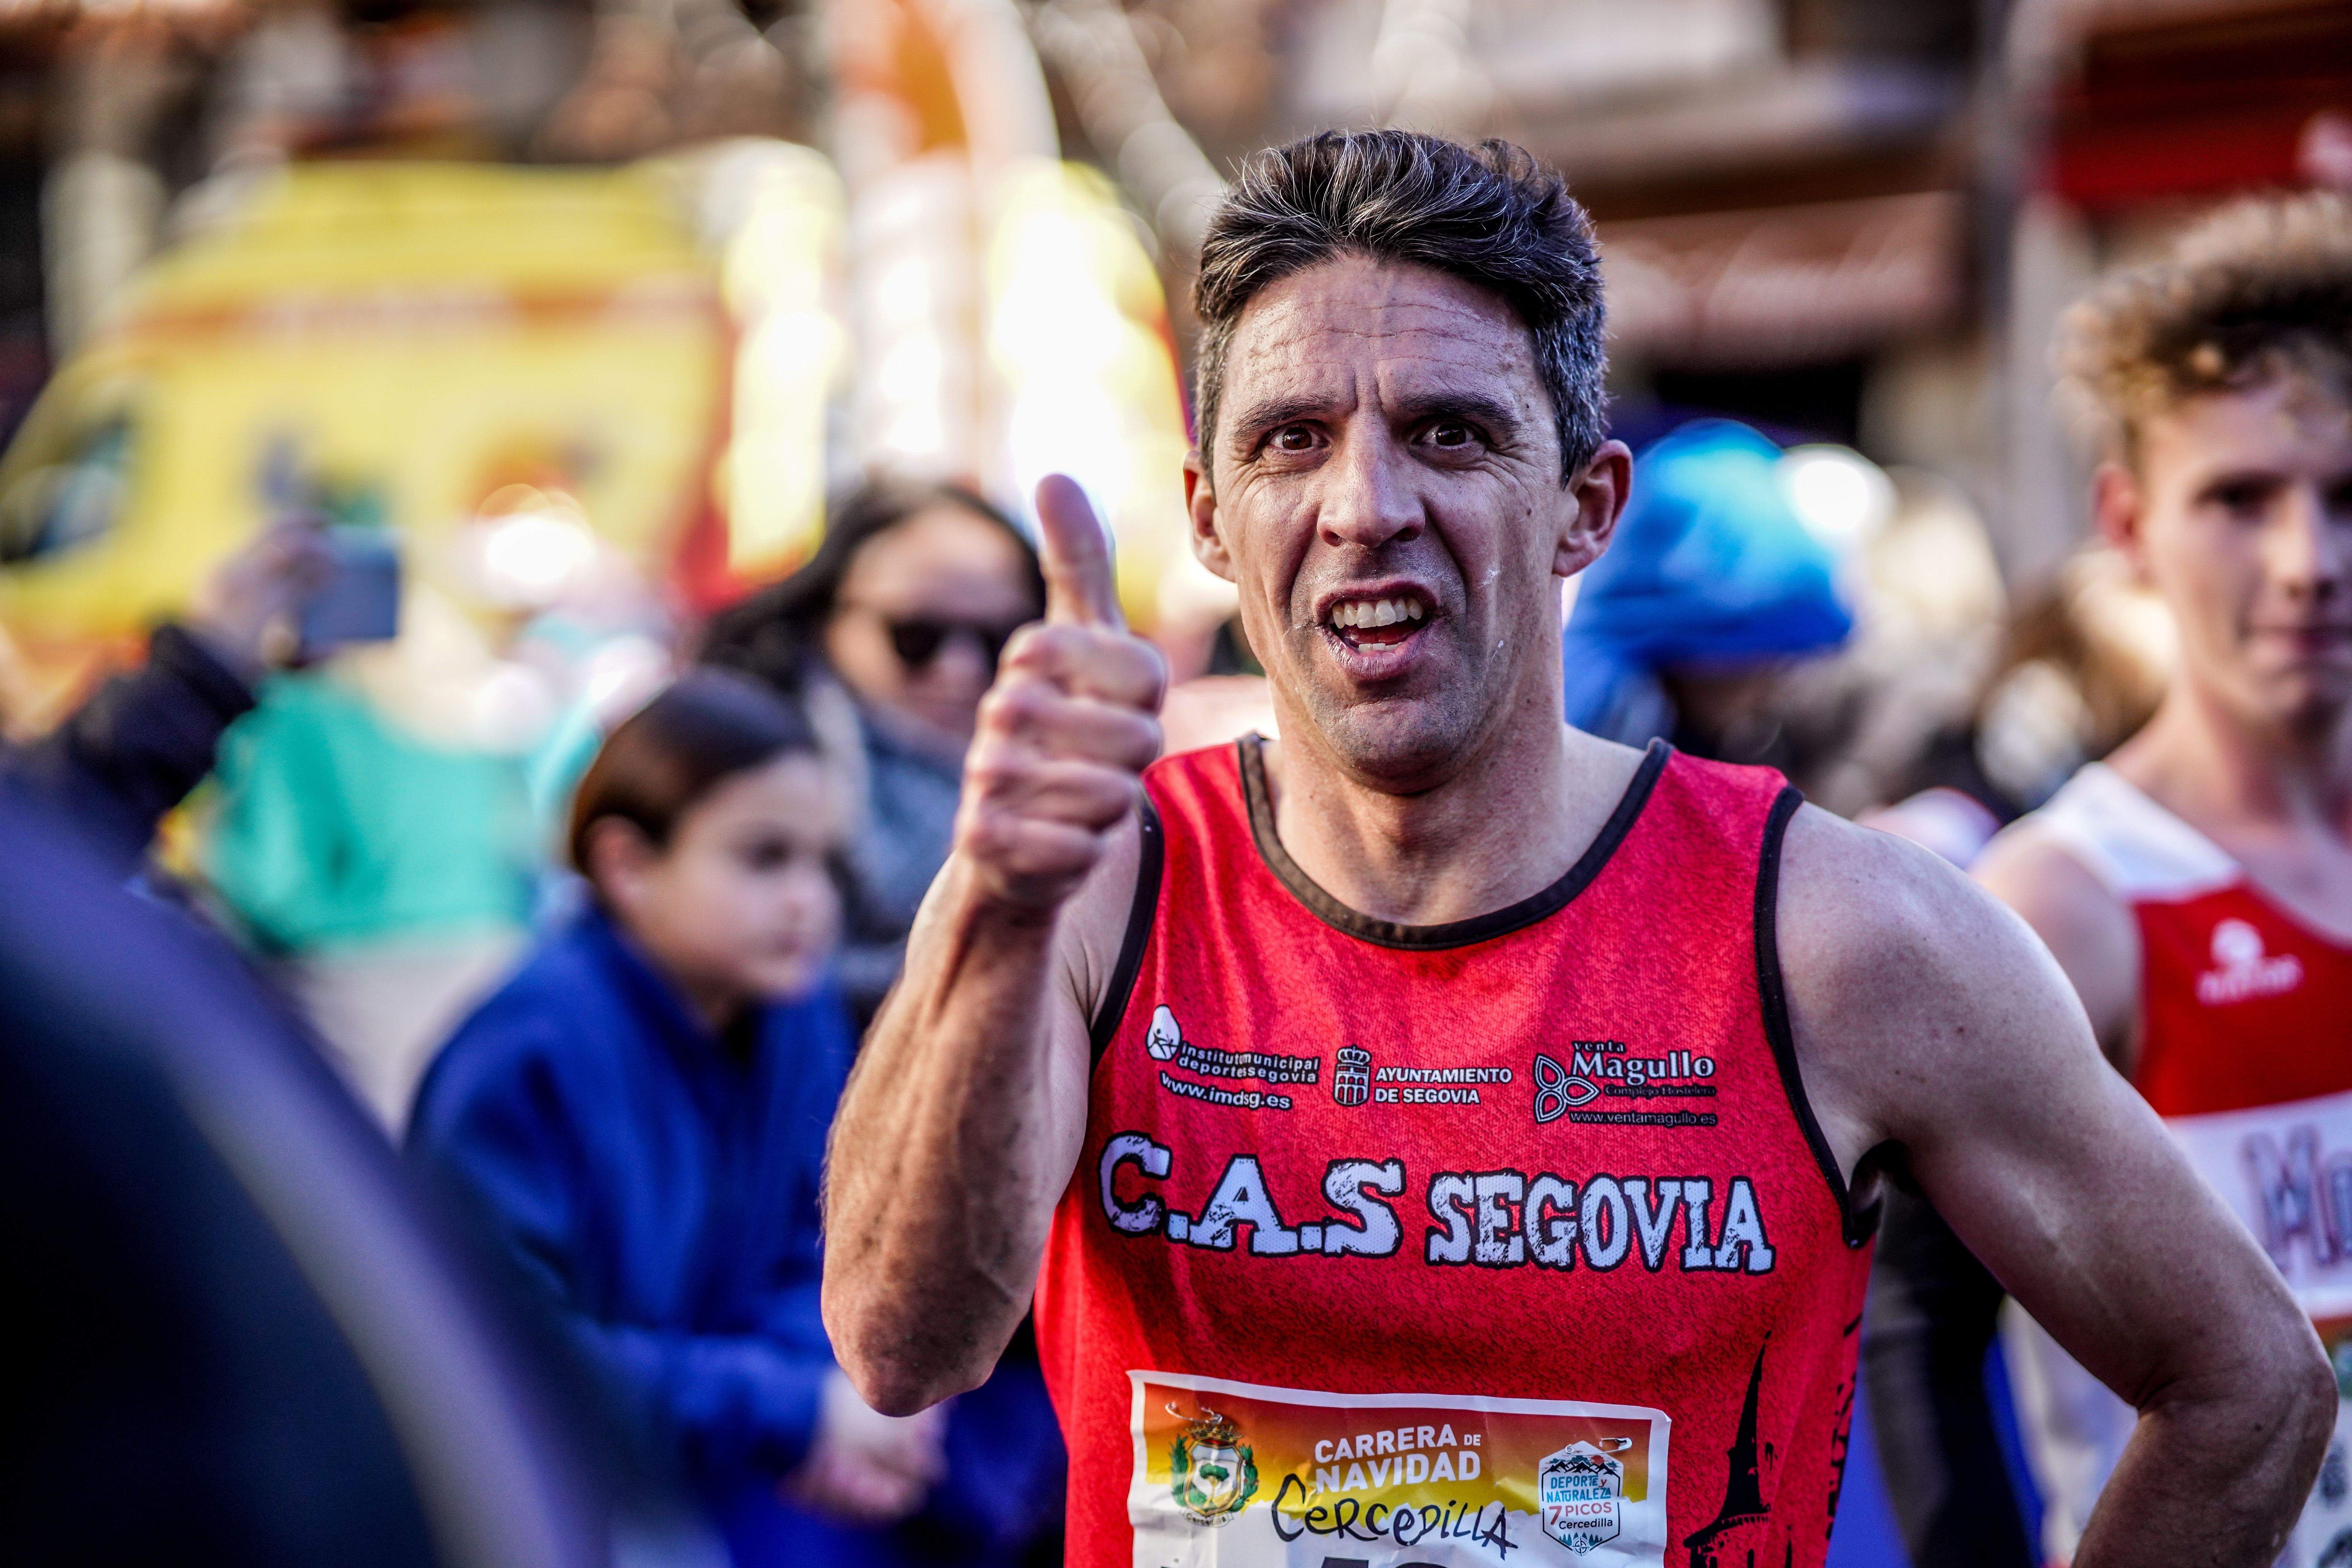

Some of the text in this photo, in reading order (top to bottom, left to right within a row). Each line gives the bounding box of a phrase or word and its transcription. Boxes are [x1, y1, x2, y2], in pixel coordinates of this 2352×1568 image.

[1573, 1041, 1625, 1052] venta
[1376, 1067, 1512, 1083] AYUNTAMIENTO
[1572, 1051, 1715, 1085] Magullo
[1161, 1072, 1291, 1109] www.imdsg.es
[1375, 1089, 1480, 1104] DE SEGOVIA
[1605, 1085, 1715, 1098] Complejo Hostelero
[1571, 1112, 1716, 1126] www.ventamagullo.es
[1100, 1133, 1774, 1273] C.A.S SEGOVIA
[1315, 1424, 1481, 1463] CARRERA DE
[1315, 1450, 1481, 1494] NAVIDAD
[1551, 1475, 1607, 1489] DEPORTE y
[1547, 1487, 1611, 1503] NATURALEZA
[1549, 1502, 1612, 1525] 7 PICOS
[1559, 1517, 1613, 1529] Cercedilla
